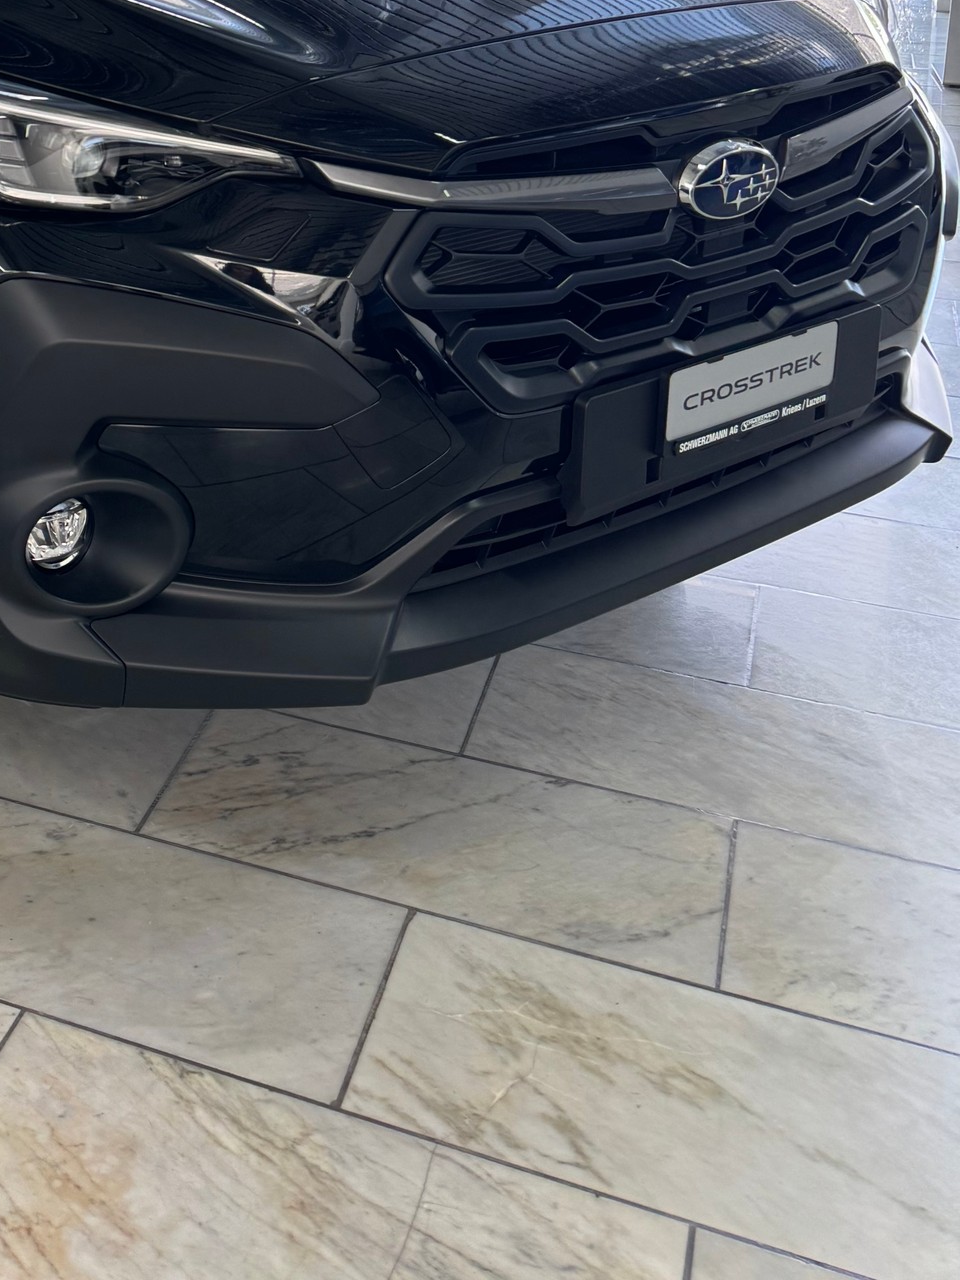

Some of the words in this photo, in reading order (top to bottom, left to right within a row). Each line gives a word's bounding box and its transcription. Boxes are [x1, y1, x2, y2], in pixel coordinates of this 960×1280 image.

[683, 351, 822, 410] CROSSTREK
[679, 431, 728, 453] SCHWERZMANN
[728, 424, 739, 436] AG
[781, 403, 802, 417] Kriens
[806, 394, 827, 408] Luzern
